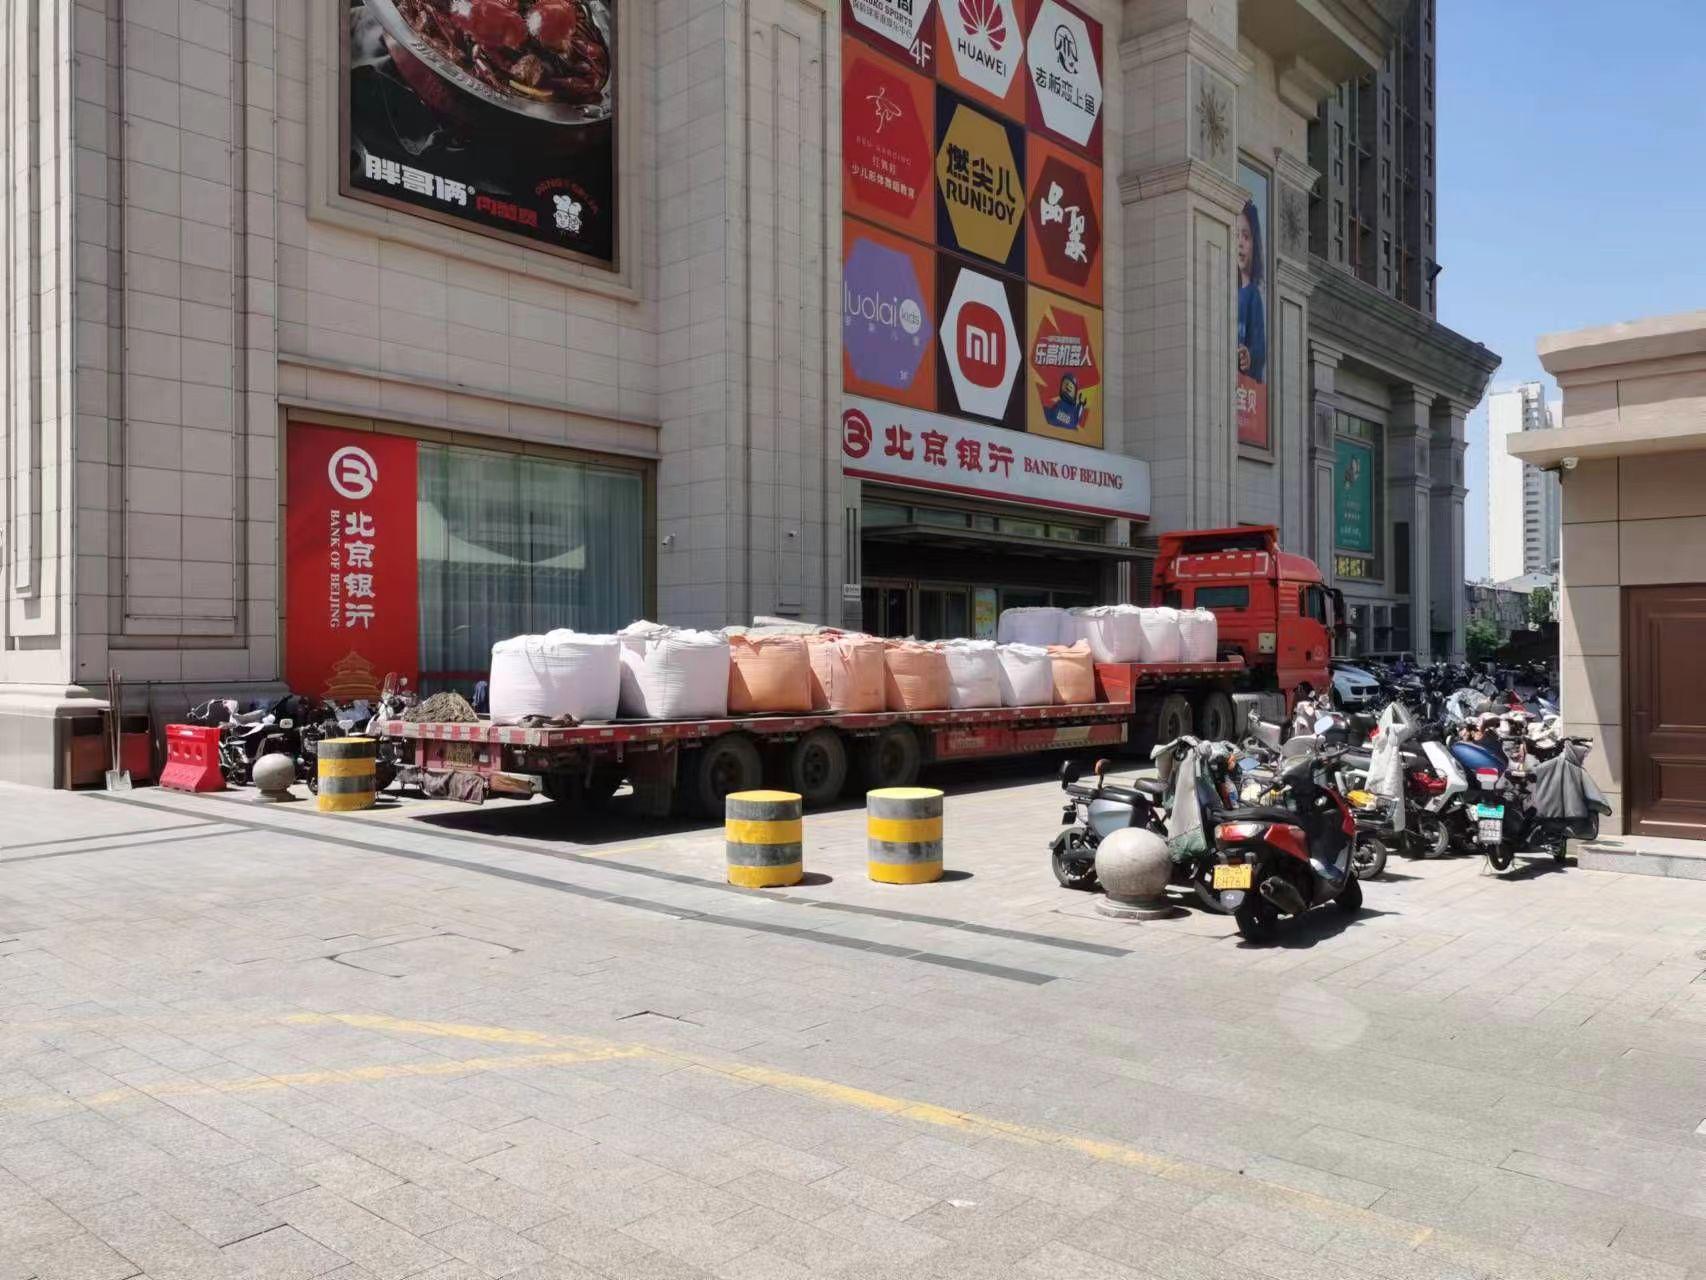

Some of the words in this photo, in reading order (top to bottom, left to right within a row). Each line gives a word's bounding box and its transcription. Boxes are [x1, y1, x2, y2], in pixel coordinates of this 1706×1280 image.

[909, 38, 932, 68] 4F
[957, 37, 1007, 78] HUAWEI
[365, 153, 468, 207] 胖哥俩
[1034, 343, 1093, 367] 乐高机器人
[884, 424, 1015, 479] 北京银行
[1023, 456, 1058, 479] BANK
[1061, 465, 1078, 482] OF
[1079, 469, 1123, 491] BEIJING
[330, 509, 340, 547] BANK
[330, 550, 340, 570] OF
[344, 509, 376, 629] 北京银行
[329, 573, 340, 629] BEIJING
